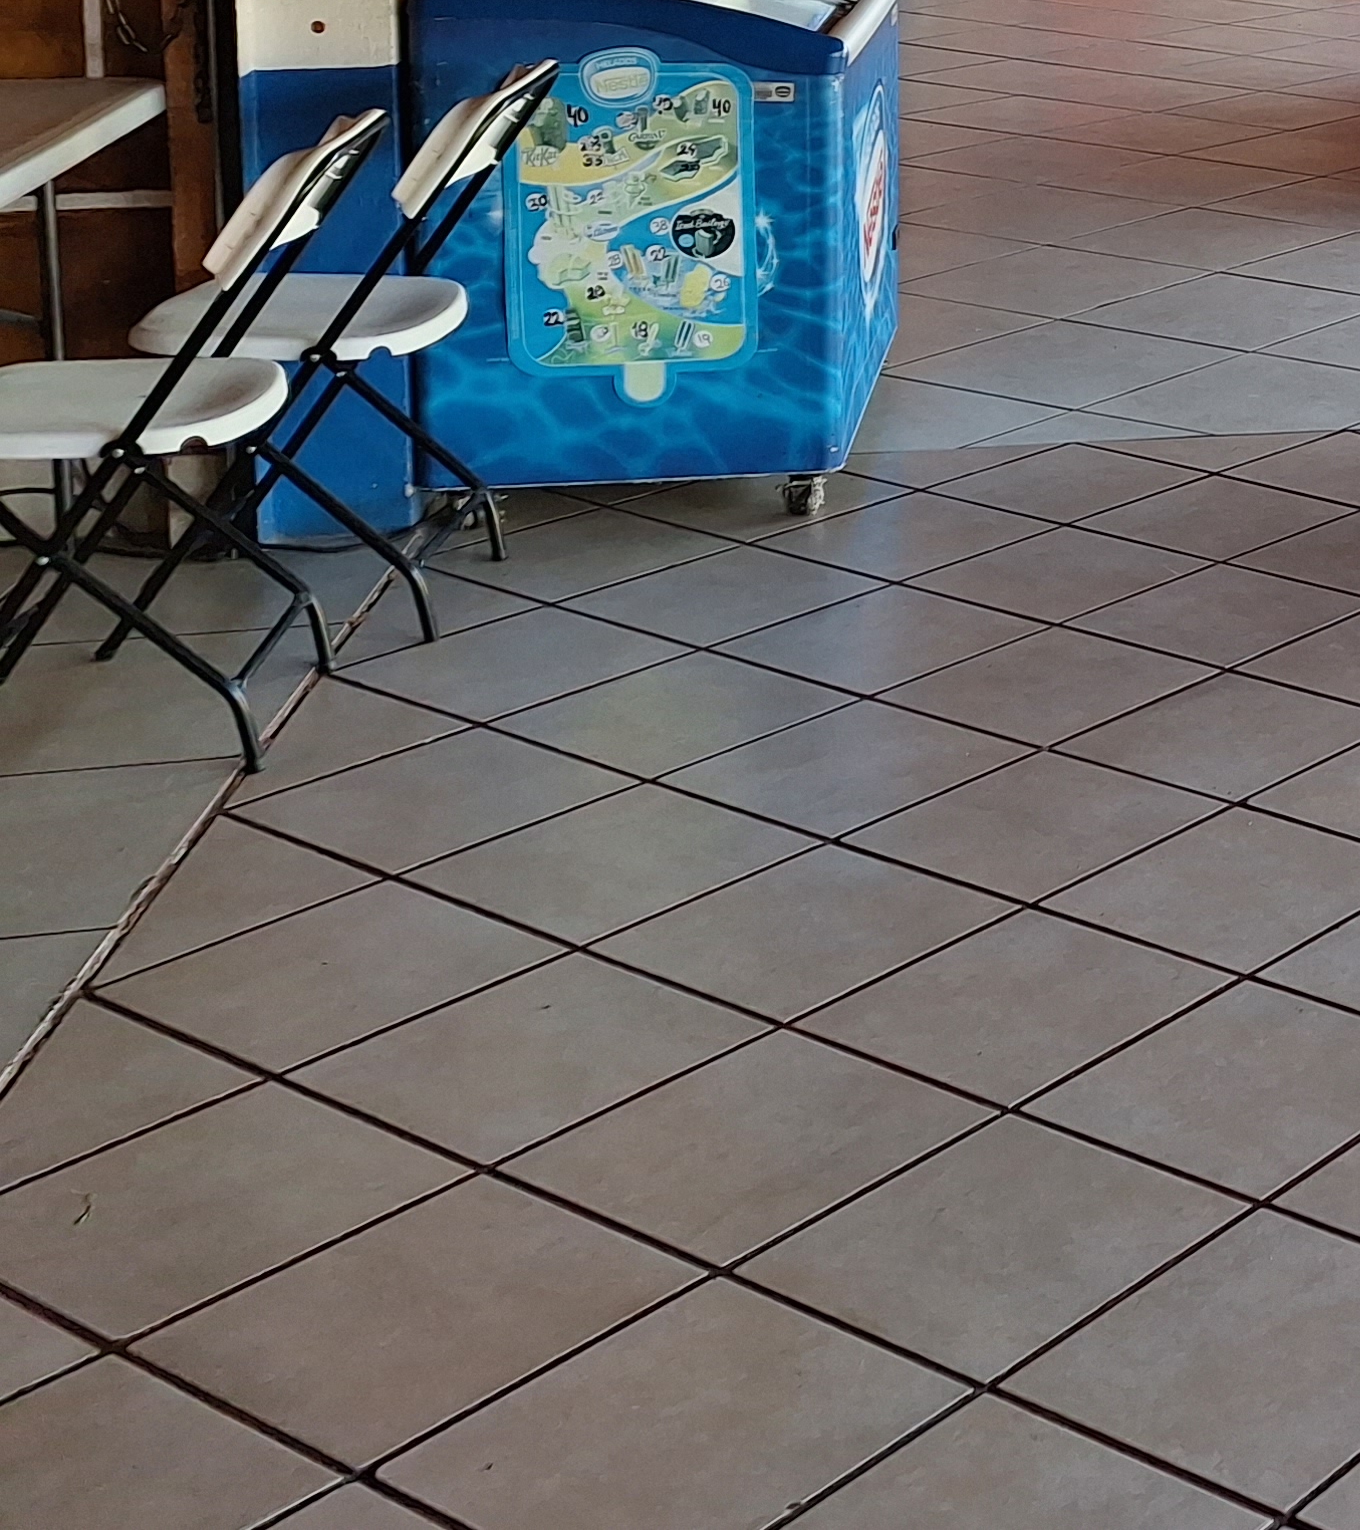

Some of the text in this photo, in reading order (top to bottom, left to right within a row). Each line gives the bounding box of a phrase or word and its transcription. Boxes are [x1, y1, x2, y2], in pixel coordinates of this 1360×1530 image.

[566, 104, 589, 128] 40
[713, 98, 732, 117] 40
[543, 311, 564, 326] 22
[632, 321, 649, 338] 18
